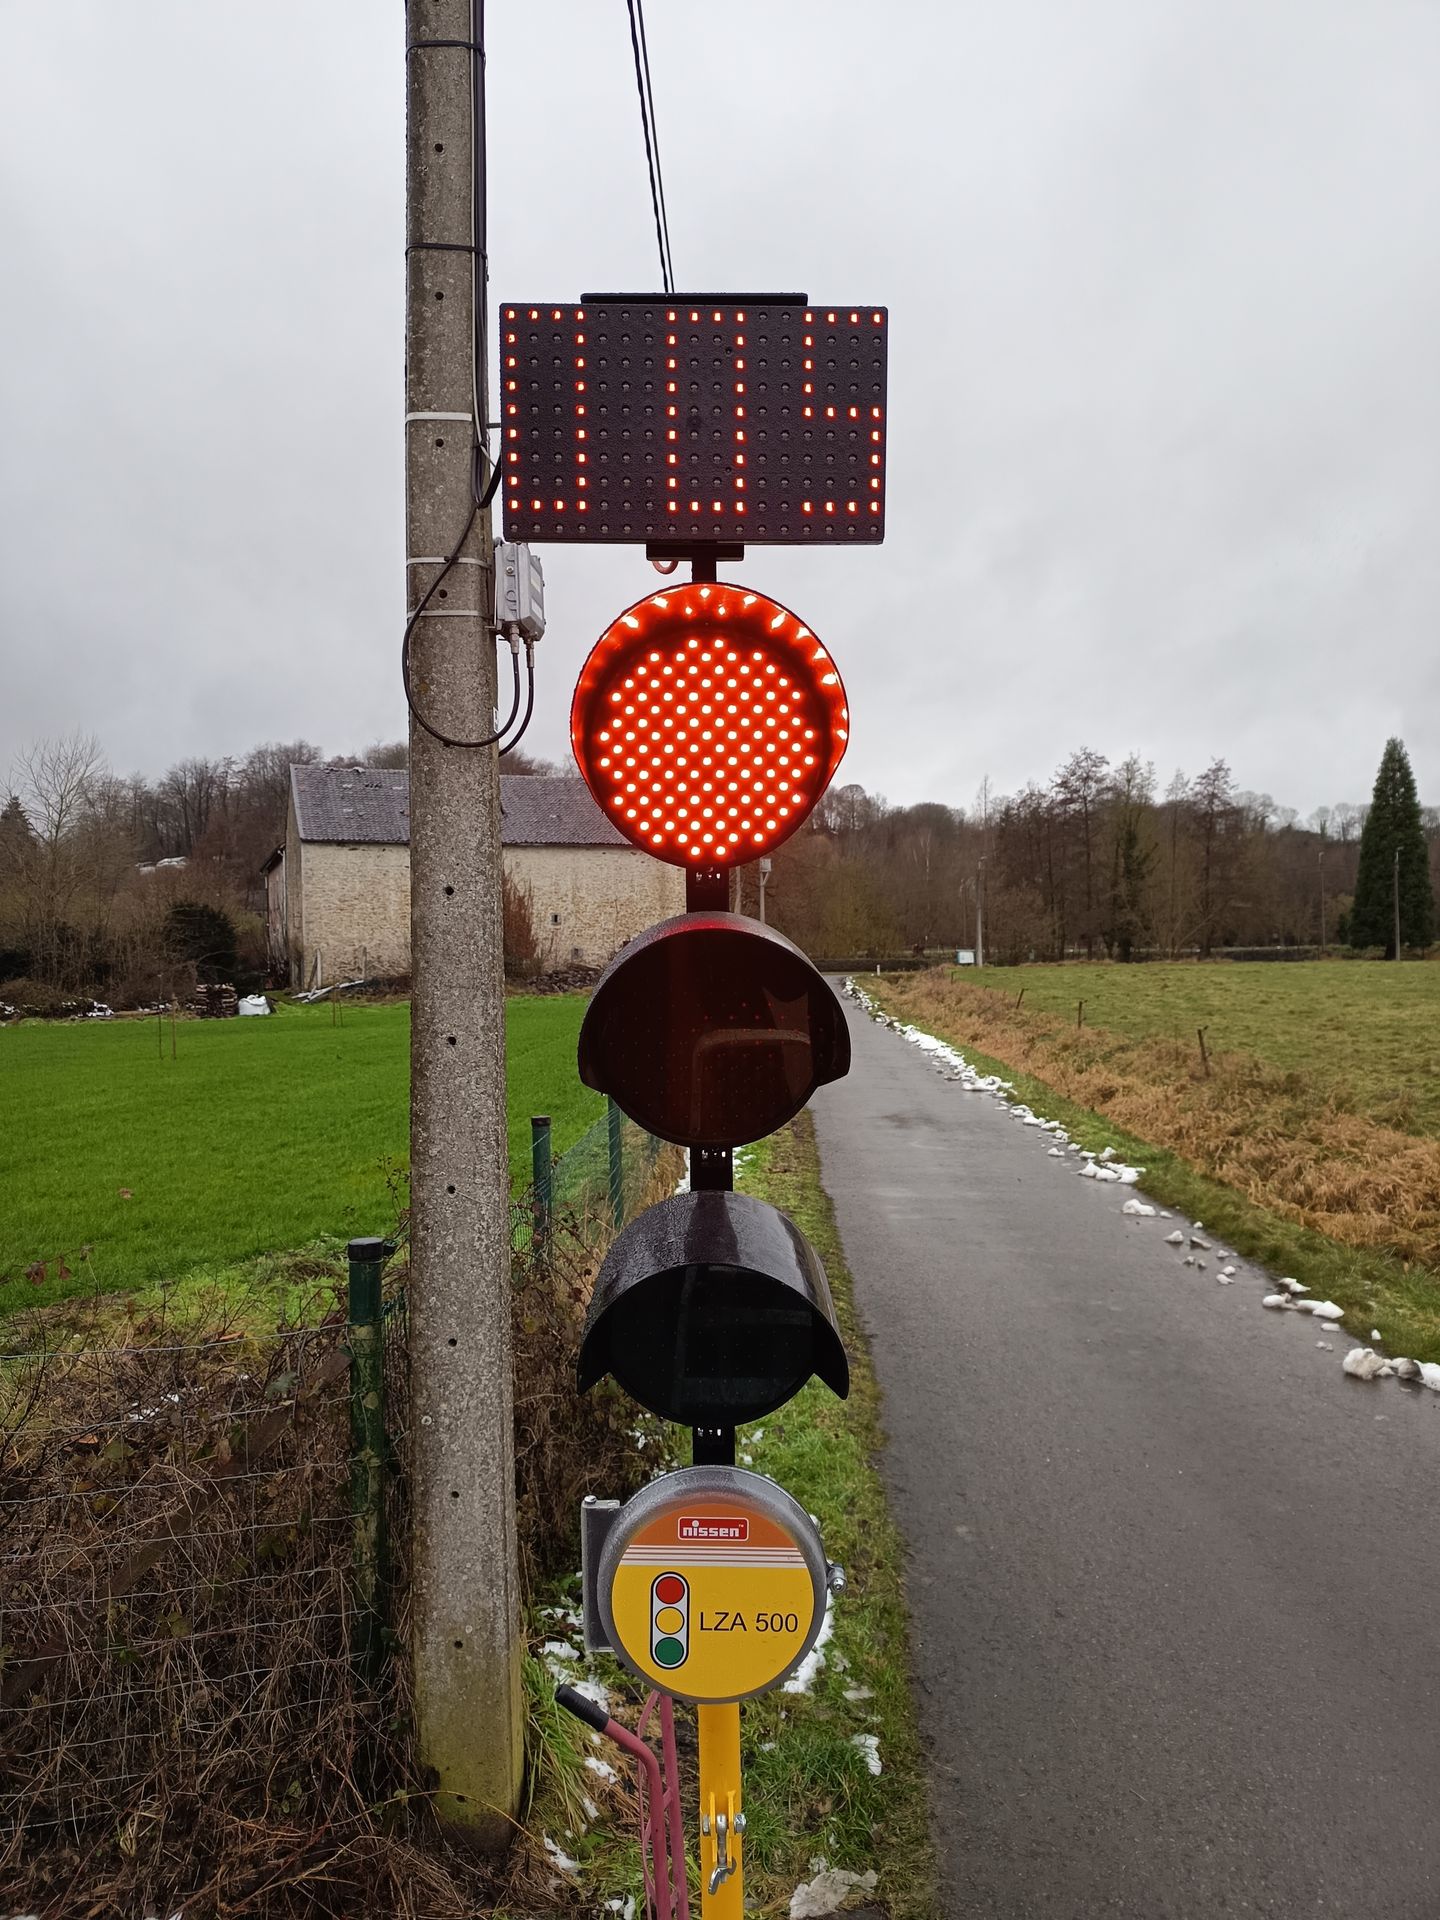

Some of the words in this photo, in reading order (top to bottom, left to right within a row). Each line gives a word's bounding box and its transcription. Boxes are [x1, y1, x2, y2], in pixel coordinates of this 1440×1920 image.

[682, 1520, 740, 1538] nissen
[699, 1612, 747, 1632] LZA
[755, 1613, 798, 1633] 500
